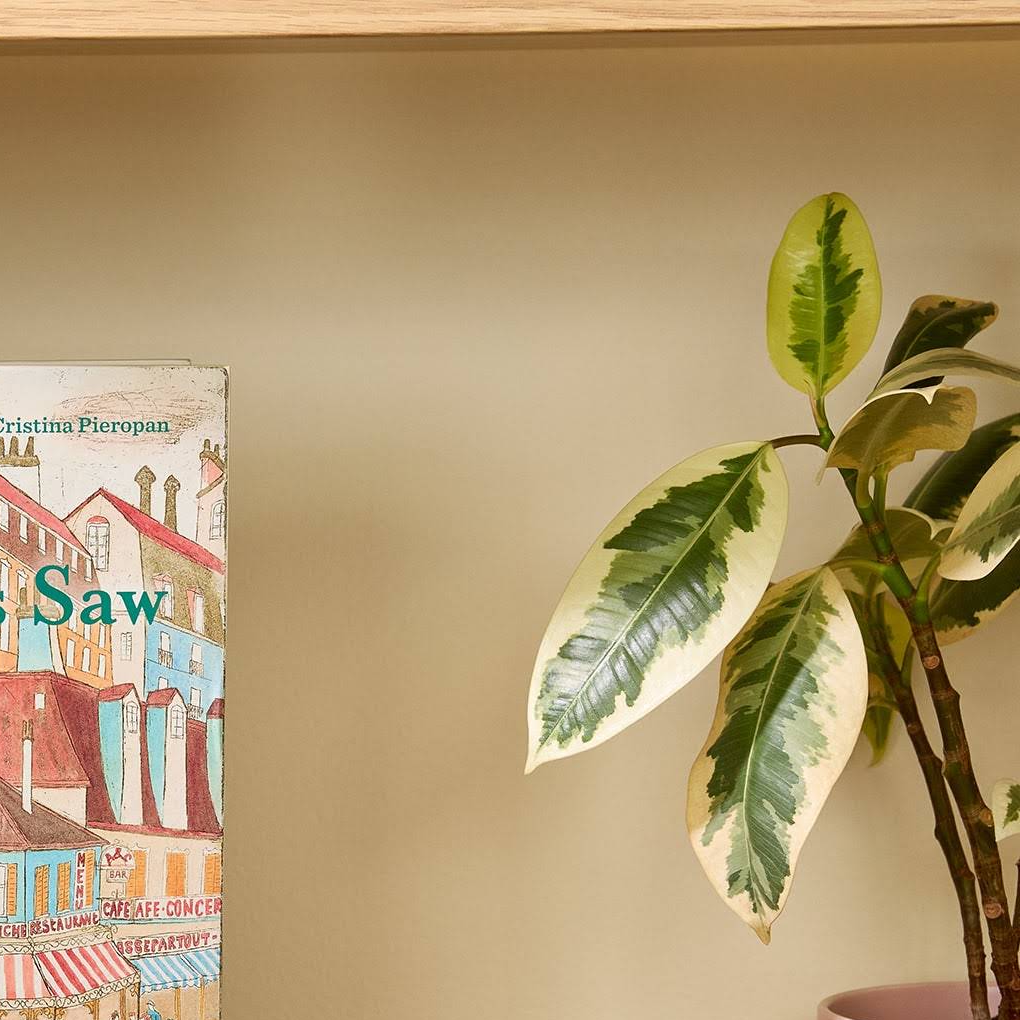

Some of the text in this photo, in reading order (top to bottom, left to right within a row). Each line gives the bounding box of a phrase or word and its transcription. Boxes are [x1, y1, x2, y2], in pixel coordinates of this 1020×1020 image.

[78, 418, 170, 438] Pieropan
[33, 565, 169, 625] Saw
[110, 871, 128, 879] BAR
[103, 900, 130, 919] CAFE
